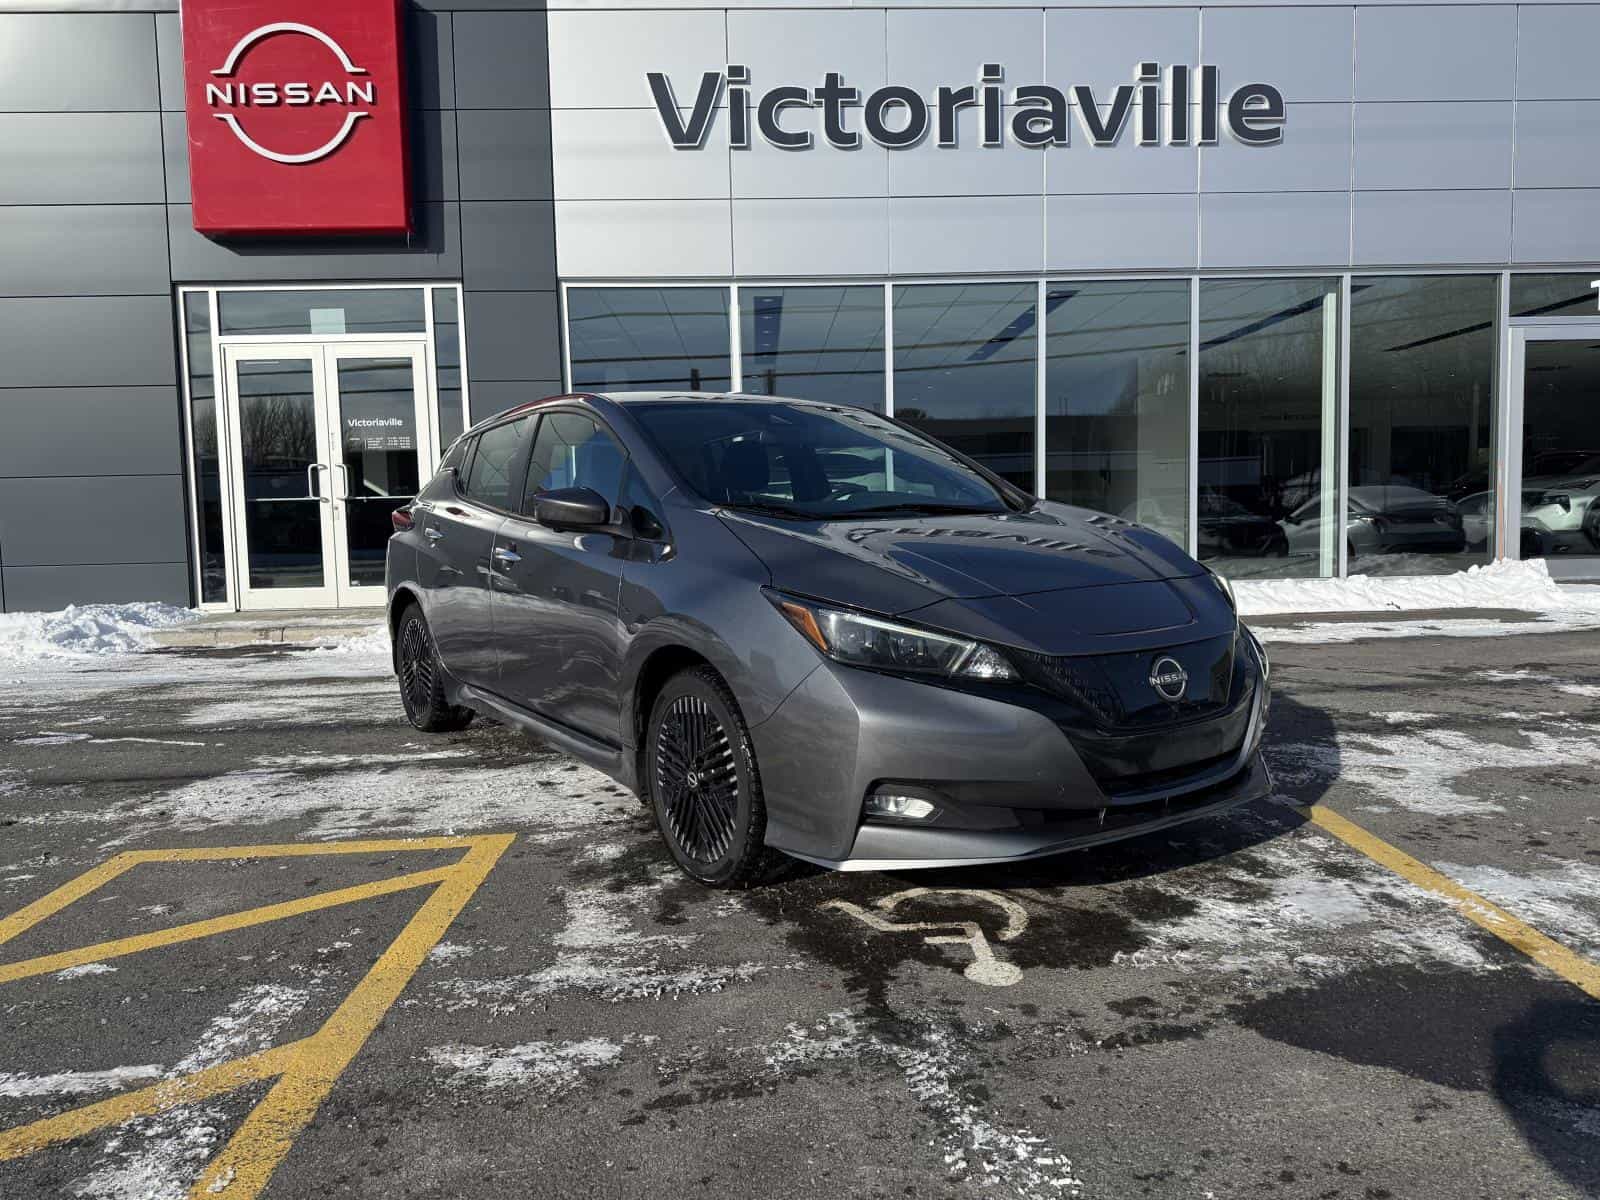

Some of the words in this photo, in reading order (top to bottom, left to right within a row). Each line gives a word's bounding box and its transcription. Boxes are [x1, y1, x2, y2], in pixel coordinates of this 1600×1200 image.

[206, 81, 374, 105] NISSAN
[646, 63, 1286, 150] Victoriaville
[347, 418, 404, 427] Victoriaville
